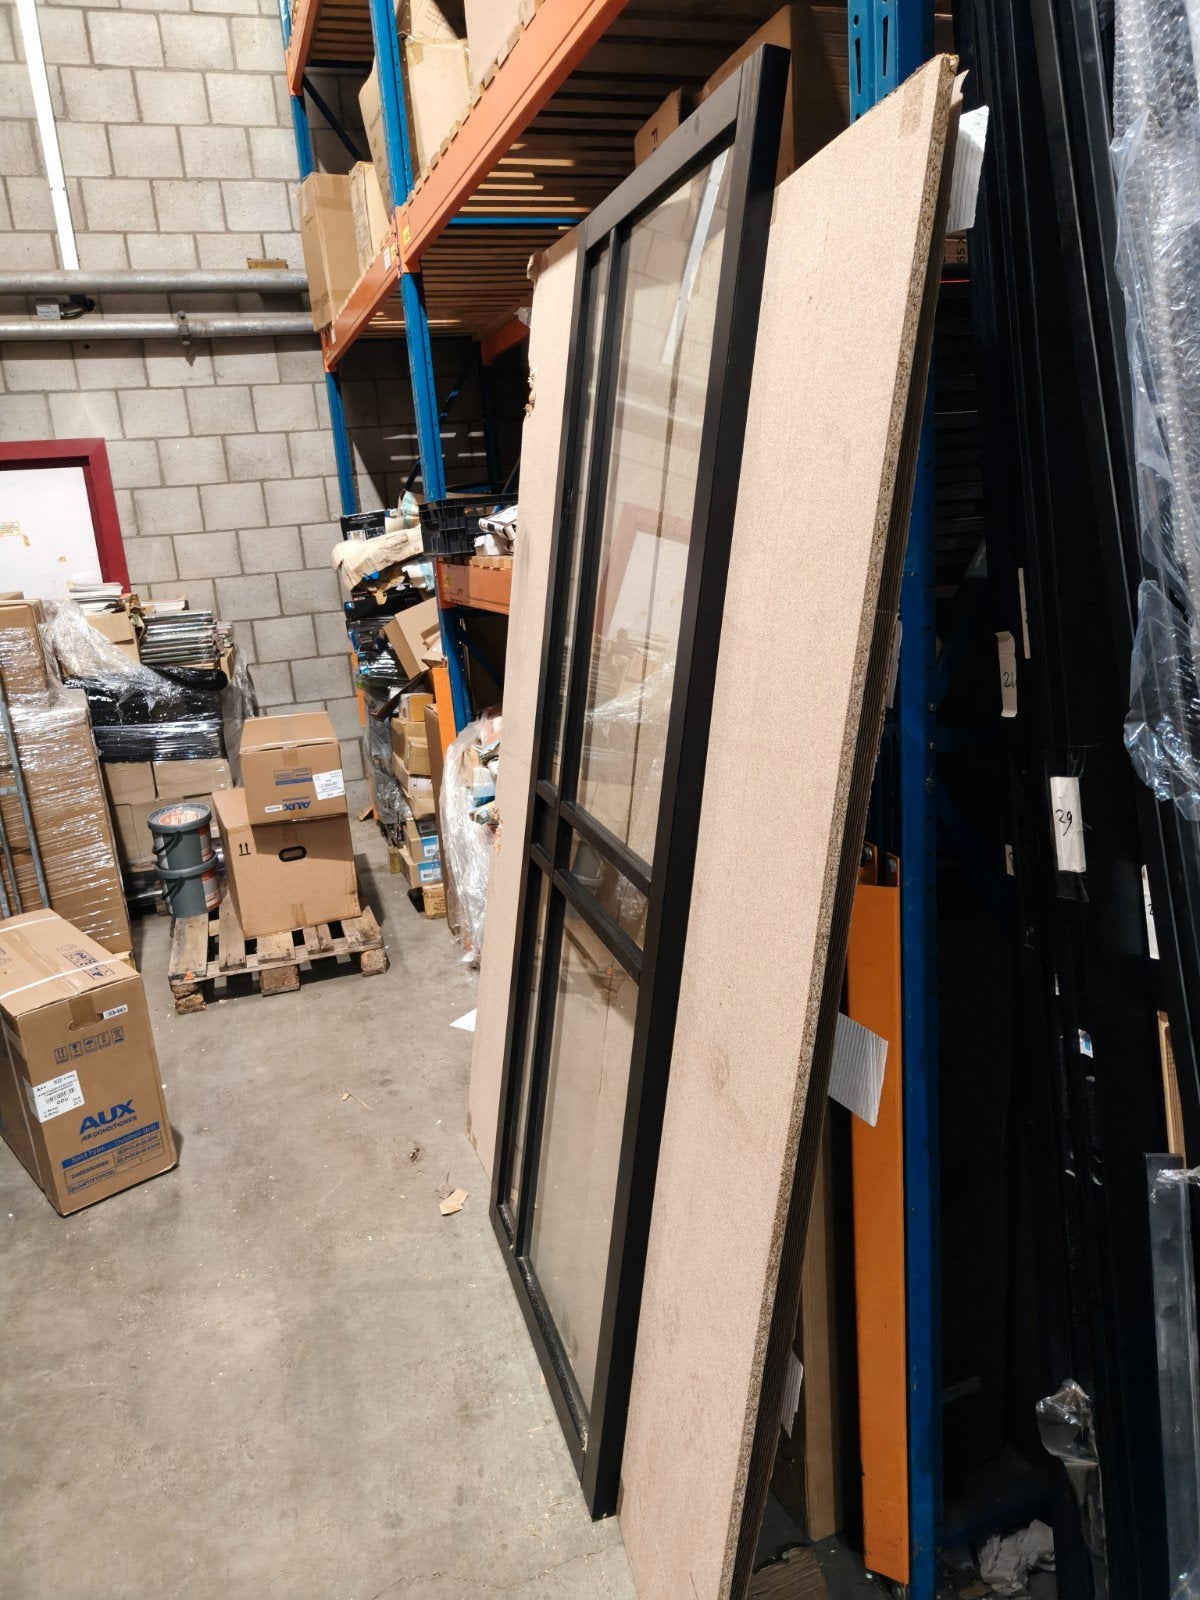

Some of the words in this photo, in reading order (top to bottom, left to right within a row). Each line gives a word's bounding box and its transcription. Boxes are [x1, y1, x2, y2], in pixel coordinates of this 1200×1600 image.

[1003, 671, 1015, 688] 21
[283, 800, 311, 811] AUX
[1055, 809, 1073, 837] 29
[79, 1099, 136, 1134] AUX
[93, 1115, 138, 1138] CONDITIONER
[89, 1146, 107, 1157] Type
[115, 1131, 141, 1146] Outdoor
